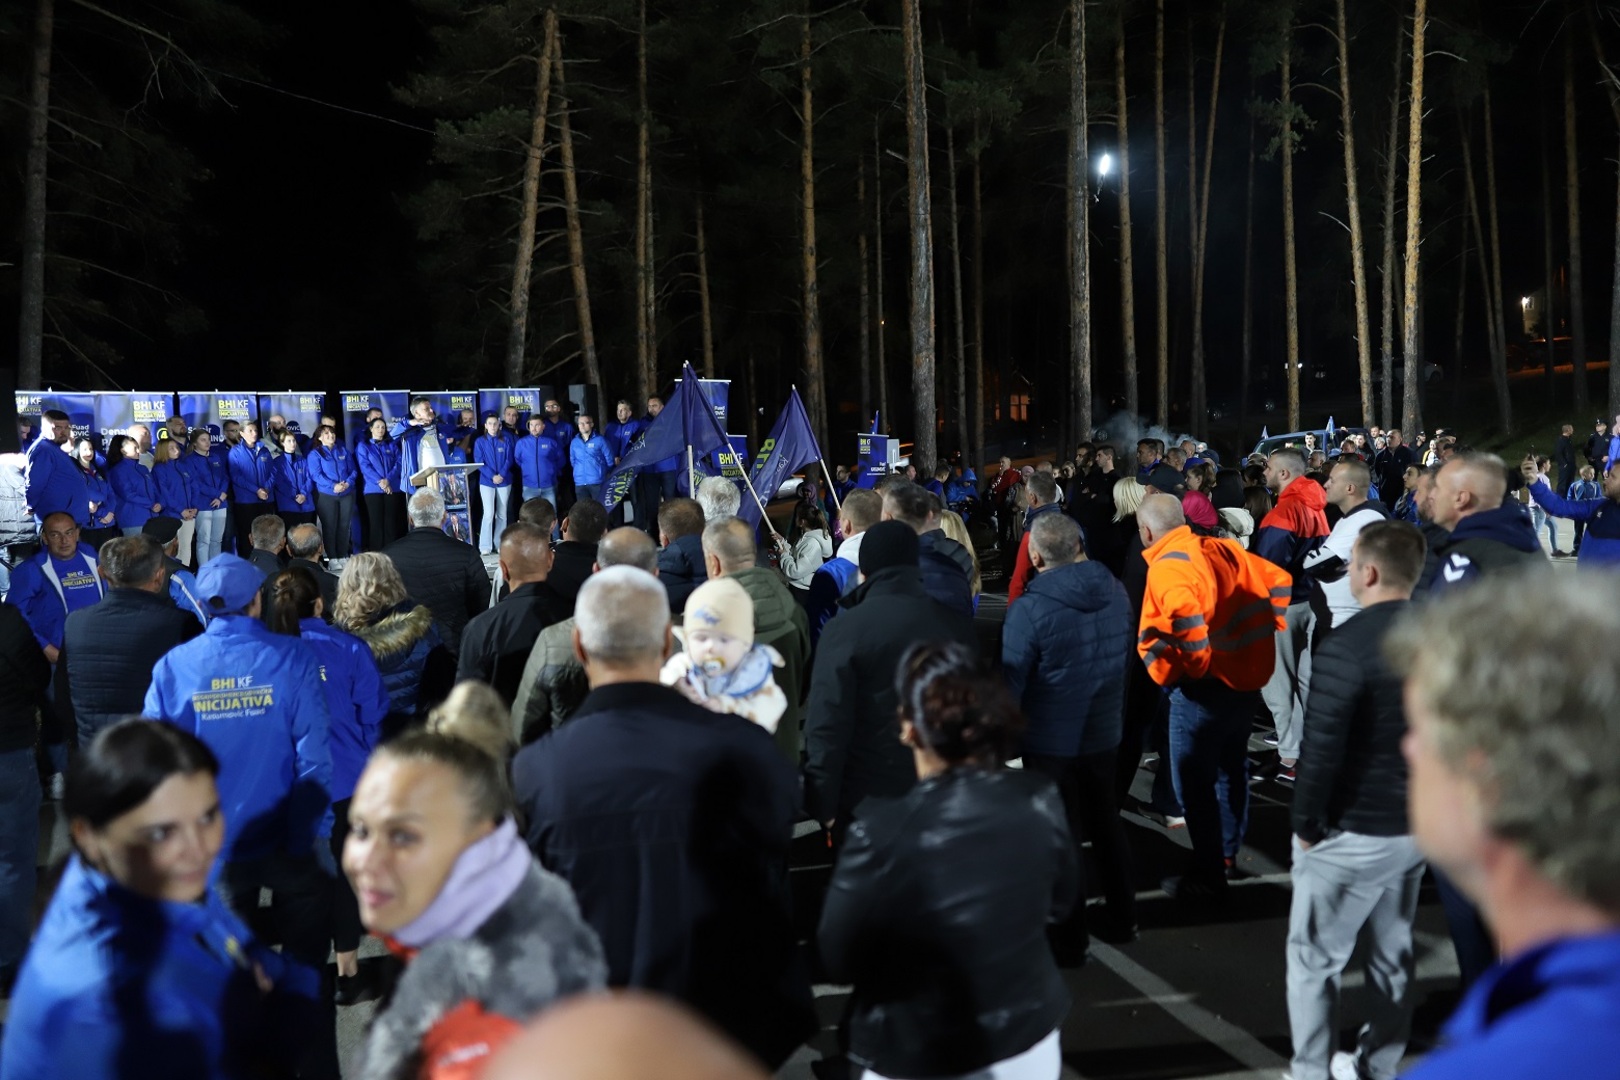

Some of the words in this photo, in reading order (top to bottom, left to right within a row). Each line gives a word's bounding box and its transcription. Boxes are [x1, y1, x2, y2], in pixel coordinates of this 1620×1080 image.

[30, 396, 42, 405] KF
[300, 396, 312, 404] BHI
[346, 395, 359, 403] BHI
[360, 395, 370, 403] KF
[509, 395, 523, 404] BHI
[524, 395, 534, 403] KF
[133, 400, 152, 410] BHI
[153, 400, 165, 410] KF
[218, 399, 236, 409] BHI
[237, 399, 249, 408] KF
[718, 453, 733, 465] BHI
[211, 678, 236, 690] BHI
[237, 676, 253, 688] KF
